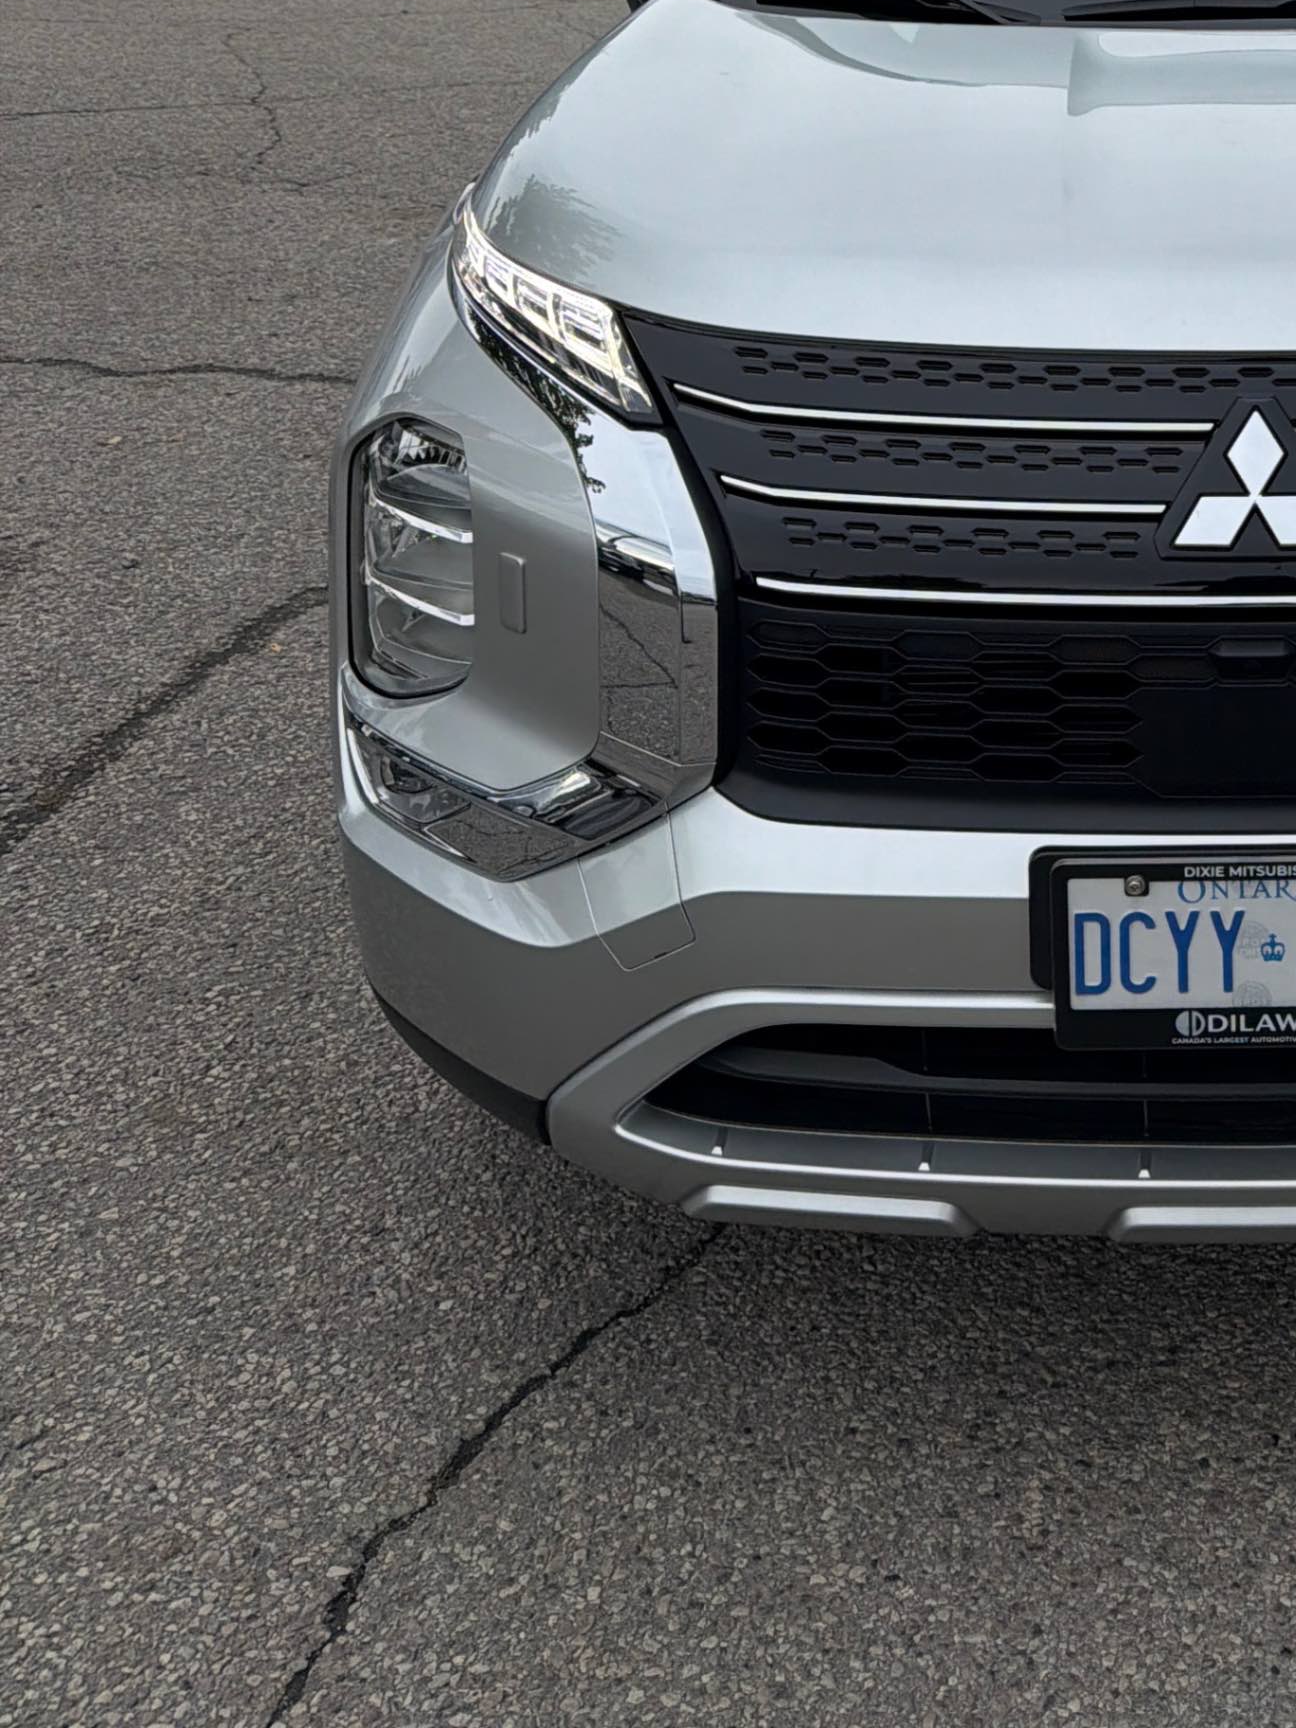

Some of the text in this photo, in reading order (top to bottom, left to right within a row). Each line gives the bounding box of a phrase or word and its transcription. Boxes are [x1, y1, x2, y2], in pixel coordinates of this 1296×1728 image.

[1184, 866, 1225, 878] DIXIE
[1074, 910, 1245, 996] DCYY
[1171, 1037, 1212, 1045] CANADA'S
